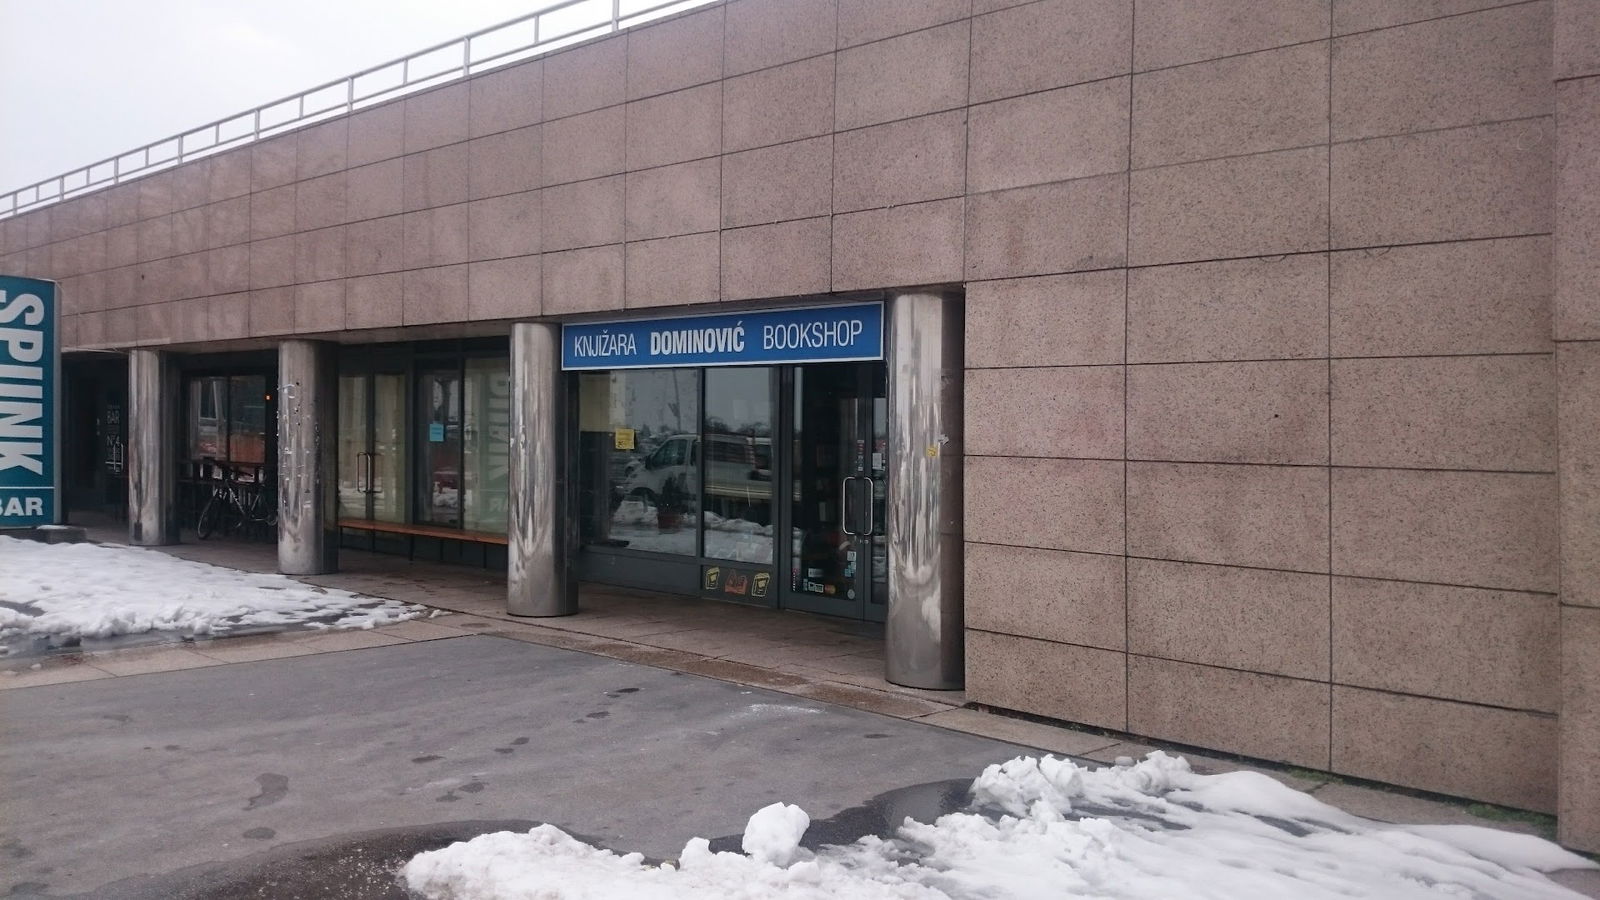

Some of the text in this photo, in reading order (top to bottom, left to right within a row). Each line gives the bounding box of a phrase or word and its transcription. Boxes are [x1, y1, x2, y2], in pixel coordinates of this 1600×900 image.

[574, 319, 863, 357] KNJIŽARA DOMINOVIĆ BOOKSHOP
[0, 498, 43, 516] AR
